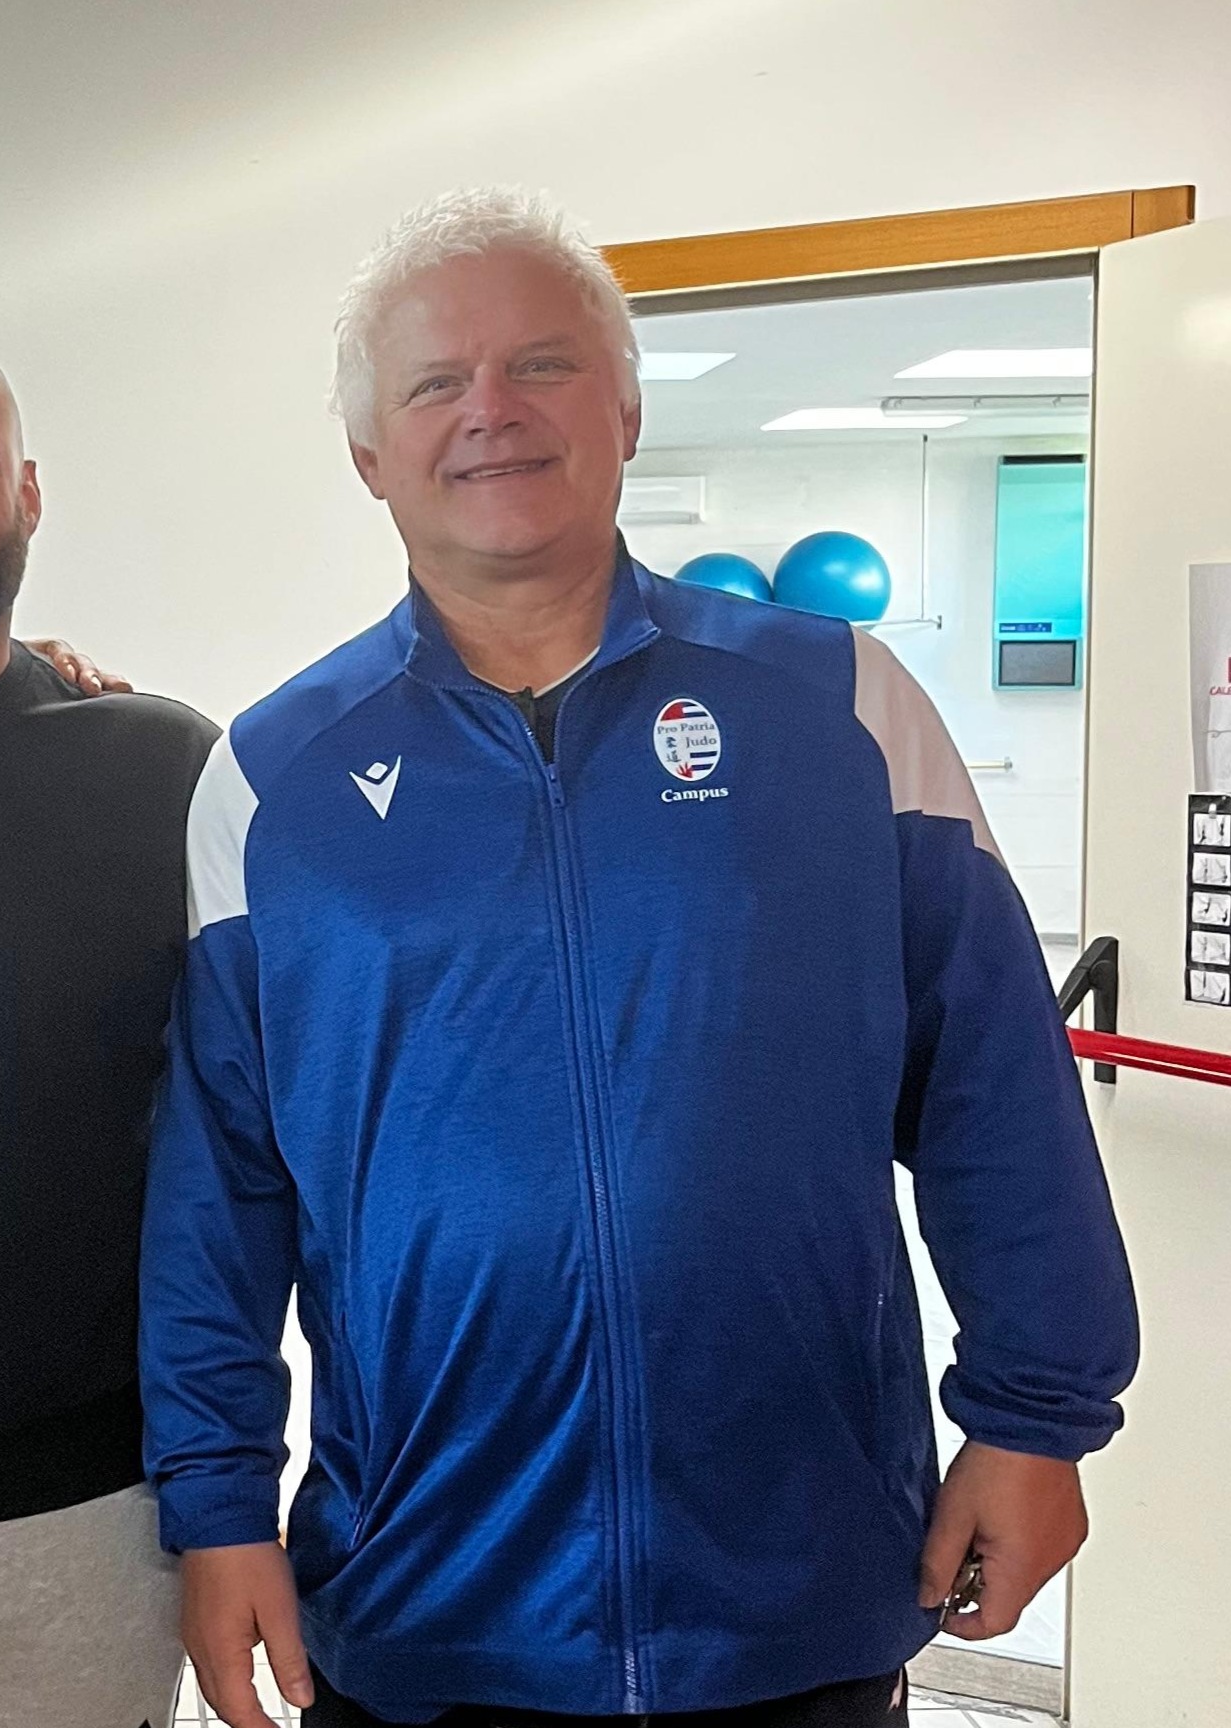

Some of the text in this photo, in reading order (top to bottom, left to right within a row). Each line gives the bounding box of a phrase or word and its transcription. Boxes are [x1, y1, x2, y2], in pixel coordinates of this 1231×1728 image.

[657, 722, 715, 735] Pro Patria
[686, 736, 717, 748] Judo
[661, 787, 729, 803] Campus
